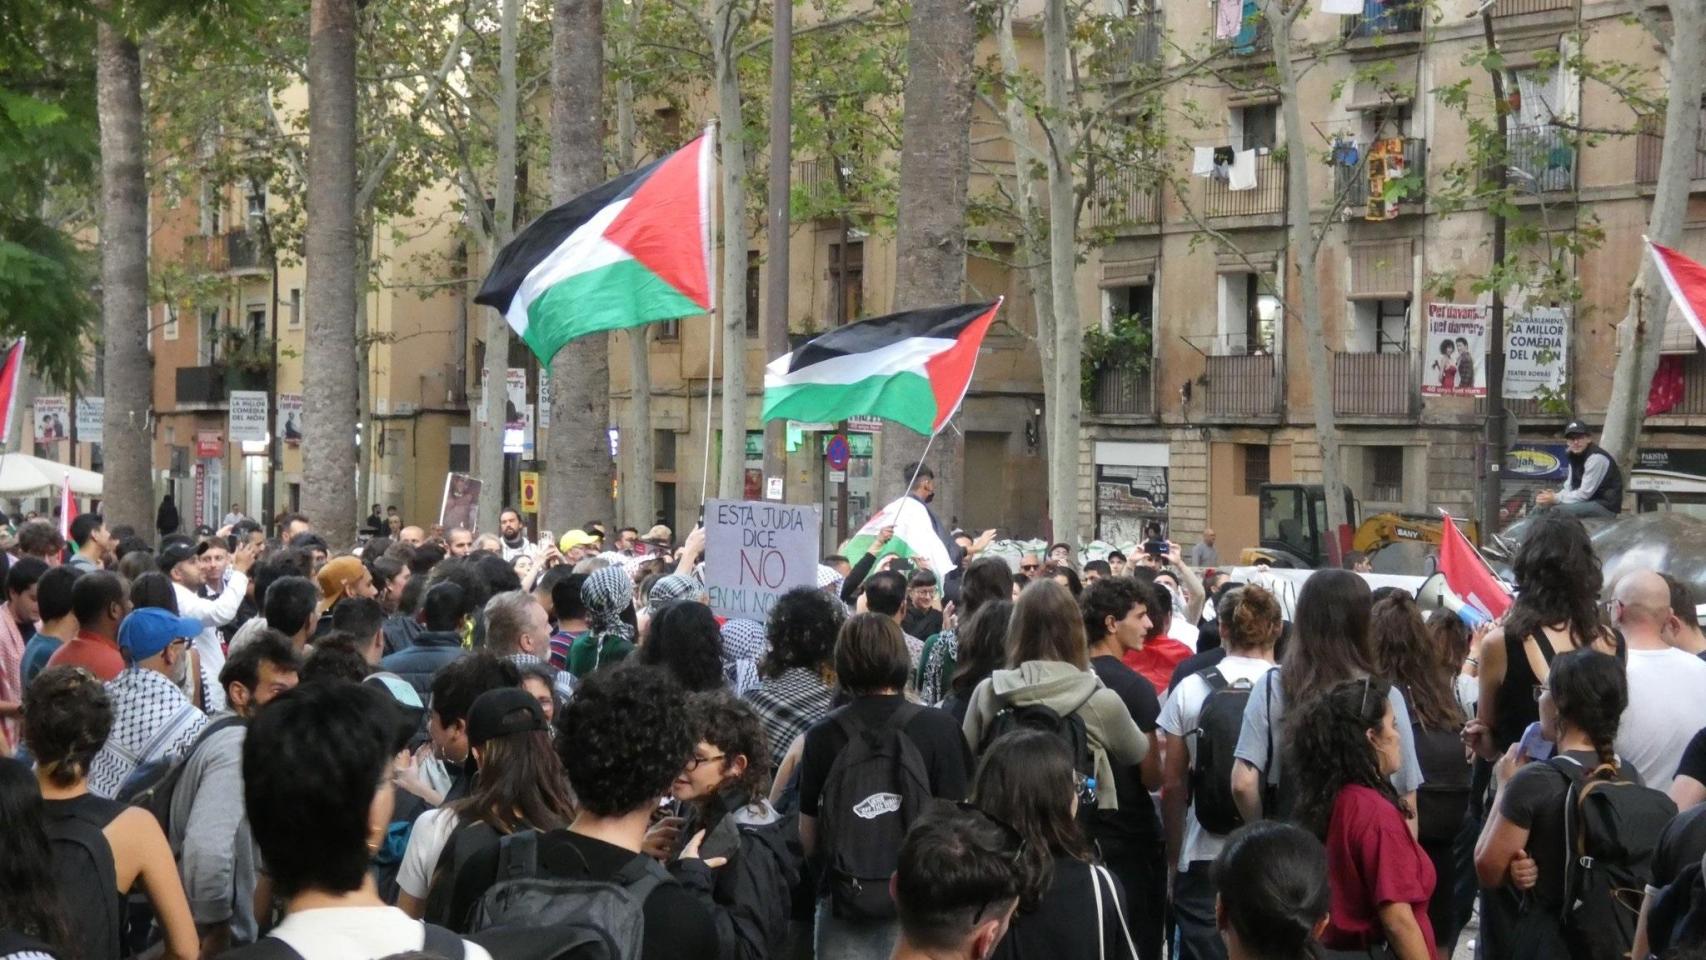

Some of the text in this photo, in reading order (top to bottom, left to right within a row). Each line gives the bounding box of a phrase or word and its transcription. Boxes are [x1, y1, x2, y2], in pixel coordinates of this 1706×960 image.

[1511, 324, 1564, 335] LA MILLOR
[1510, 349, 1561, 361] DEL MN
[718, 504, 804, 532] ESTA JUDÍA
[743, 528, 777, 548] DICE
[739, 549, 786, 589] NO
[708, 586, 728, 609] EN
[732, 589, 746, 613] MI
